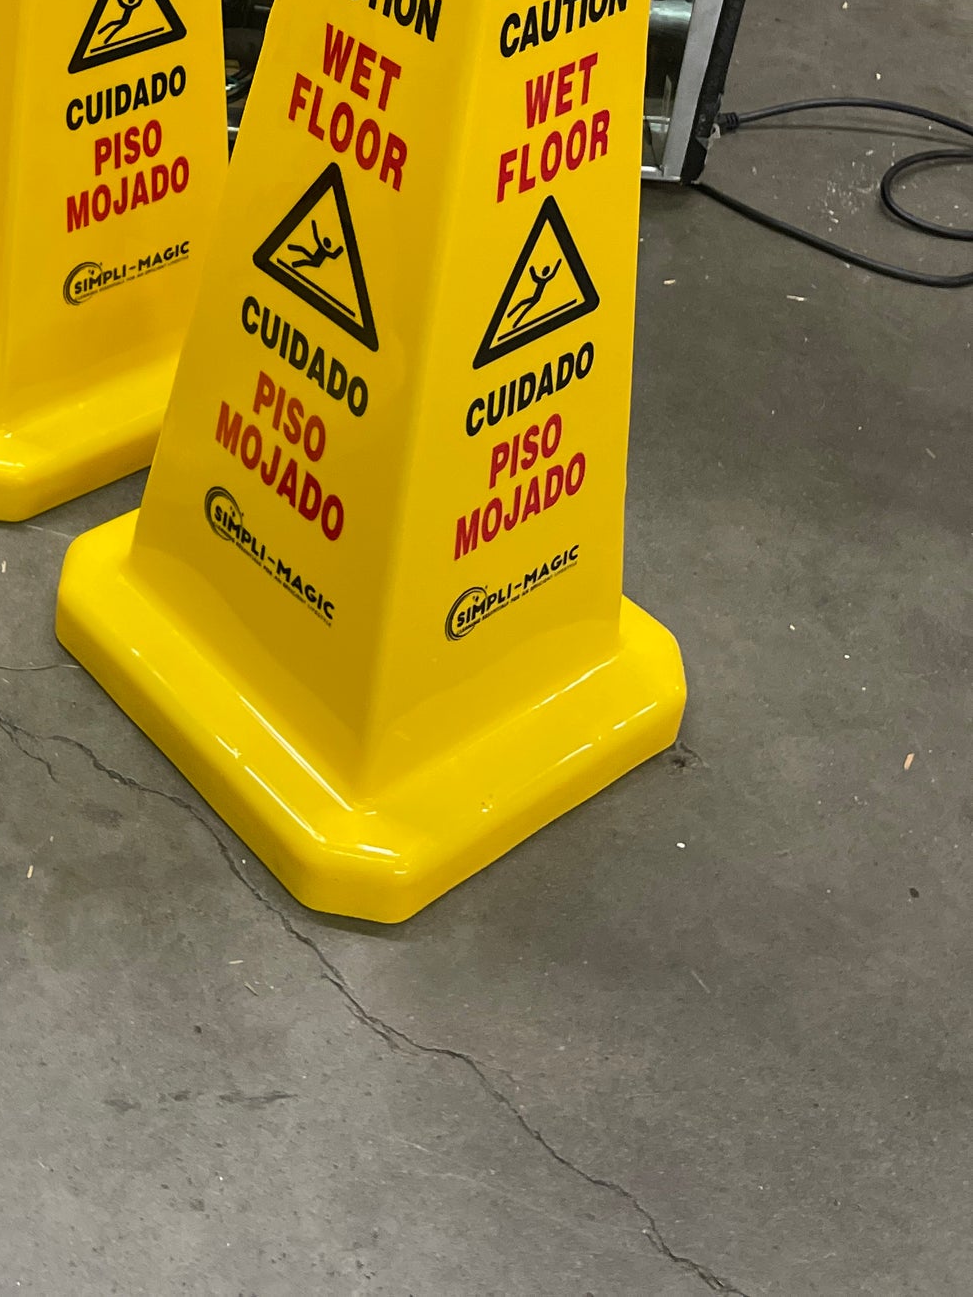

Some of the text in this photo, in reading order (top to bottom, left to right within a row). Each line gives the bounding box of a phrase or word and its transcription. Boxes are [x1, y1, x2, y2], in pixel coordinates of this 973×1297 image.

[66, 65, 186, 130] CUIDADO
[322, 23, 401, 111] WET
[526, 52, 598, 129] WET
[94, 119, 162, 176] PISO
[288, 72, 407, 192] FLOOR
[496, 109, 610, 203] FLOOR
[66, 156, 189, 233] MOJADO
[74, 241, 190, 294] SIMPLI-MAGIC
[242, 296, 368, 417] CUIDADO
[465, 341, 594, 437] CUIDADO
[253, 371, 326, 463] PISO
[489, 413, 562, 489] PISO
[215, 401, 344, 541] MOJADO
[454, 452, 586, 561] MOJADO
[215, 505, 334, 620] SIMPLI-MAGIC
[457, 545, 579, 627] SIMPLI-MAGIC
